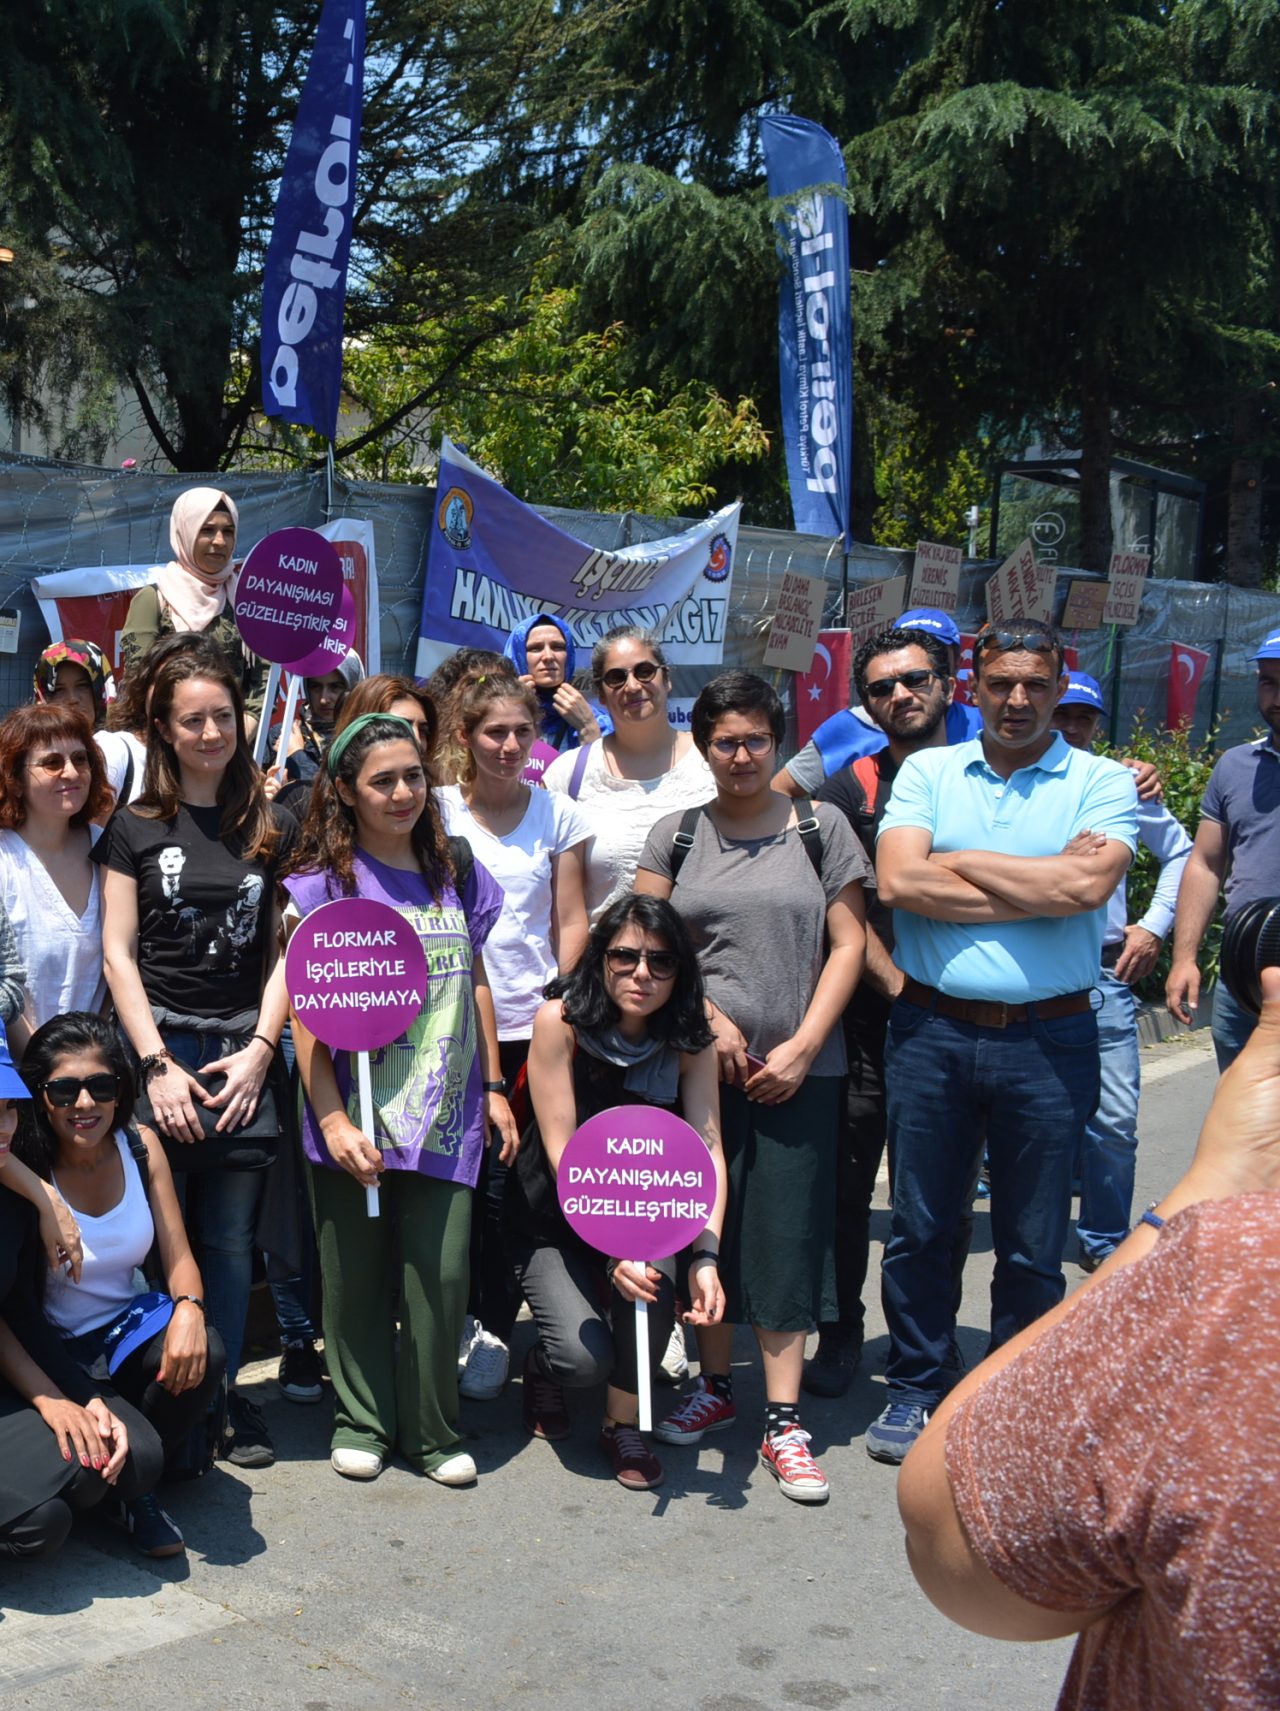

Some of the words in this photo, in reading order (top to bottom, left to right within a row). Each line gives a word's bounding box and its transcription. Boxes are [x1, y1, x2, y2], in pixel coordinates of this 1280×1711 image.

[278, 554, 319, 576] KADIN
[245, 575, 335, 607] DAYANIŞMASI
[235, 601, 332, 633] GÜZELLEŞTİRİR
[313, 930, 397, 949] FLORMAR
[306, 957, 406, 984] İŞÇİLERİYLE
[294, 989, 422, 1012] DAYANIŞMAYA
[607, 1137, 664, 1156] KADIN
[568, 1167, 703, 1190] DAYANIŞMASI
[563, 1195, 709, 1222] GÜZELLEŞTİRİR
